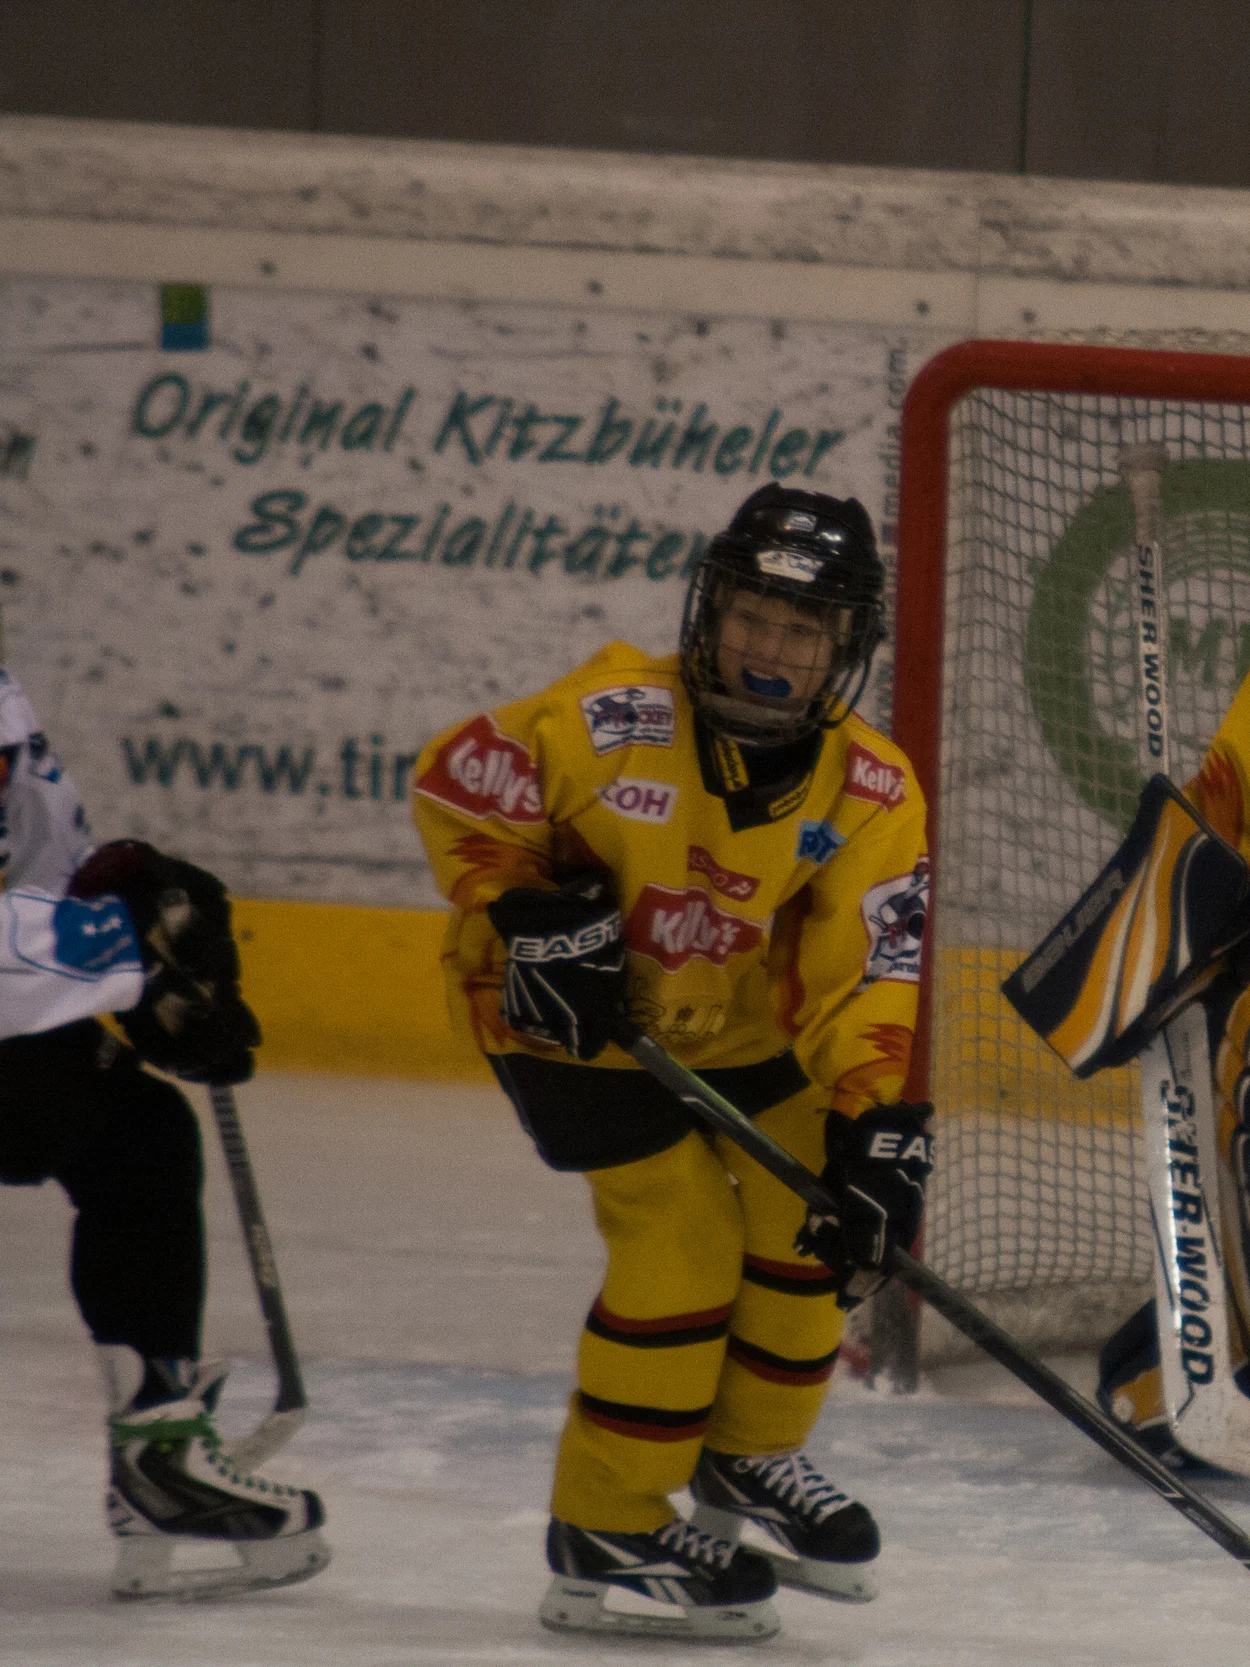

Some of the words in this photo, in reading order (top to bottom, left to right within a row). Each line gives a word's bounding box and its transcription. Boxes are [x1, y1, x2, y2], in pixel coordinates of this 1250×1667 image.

[132, 373, 416, 465] Original
[436, 389, 843, 478] Kitzbüheler
[121, 732, 418, 801] www.tir
[510, 908, 621, 963] EAST
[868, 1131, 934, 1164] EA
